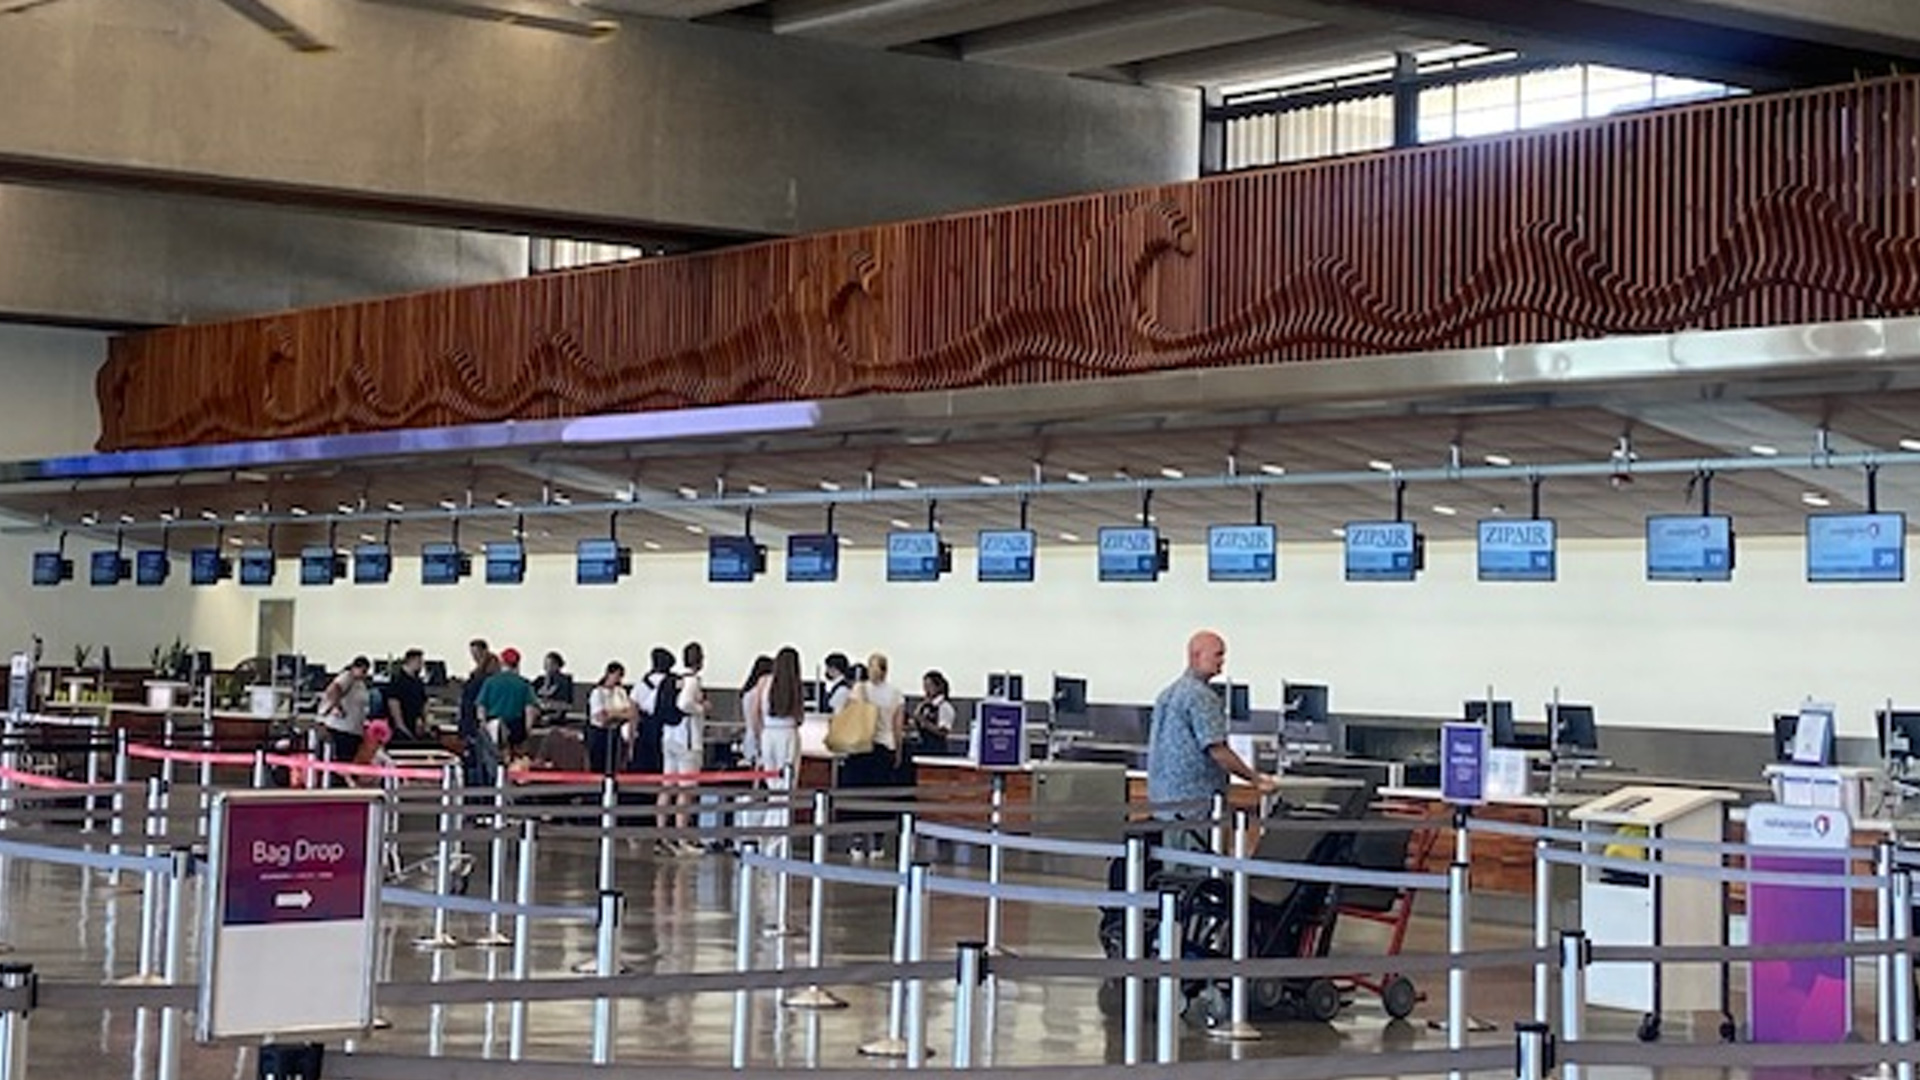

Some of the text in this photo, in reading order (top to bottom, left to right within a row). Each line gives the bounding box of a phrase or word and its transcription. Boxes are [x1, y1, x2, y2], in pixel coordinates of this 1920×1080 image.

[1351, 528, 1408, 547] ZIPAIR
[1485, 525, 1547, 545] ZIPAIR
[252, 838, 344, 867] Bag Drop
